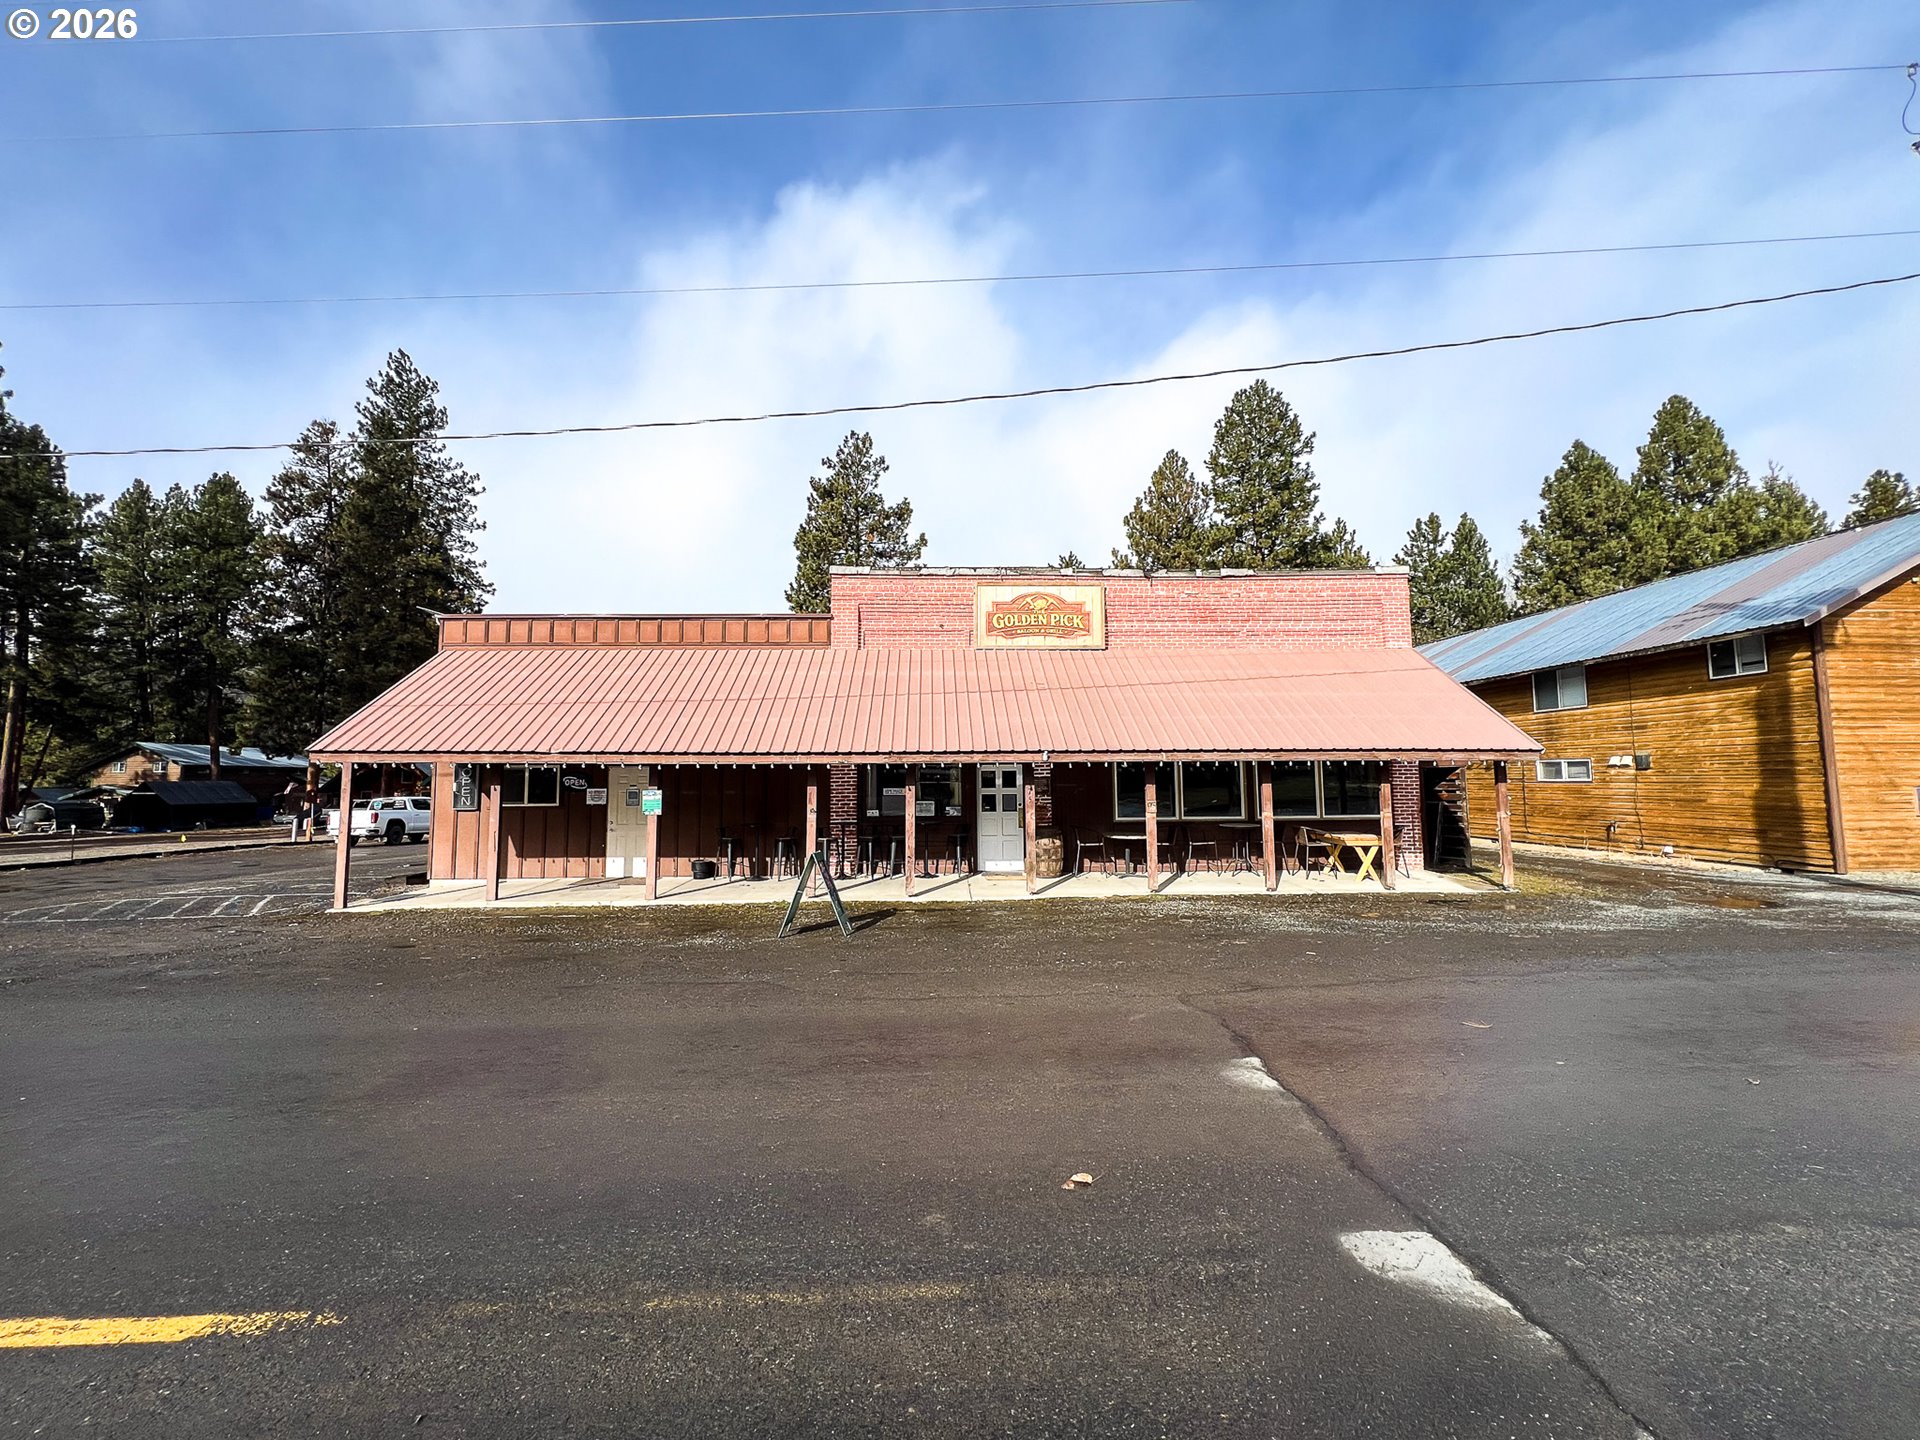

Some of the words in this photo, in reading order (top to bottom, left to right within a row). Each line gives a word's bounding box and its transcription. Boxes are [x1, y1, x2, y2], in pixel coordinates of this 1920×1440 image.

[992, 613, 1048, 628] GOLDEN
[1049, 613, 1085, 629] PICK
[461, 767, 472, 806] OPEN
[564, 778, 585, 787] OPEN
